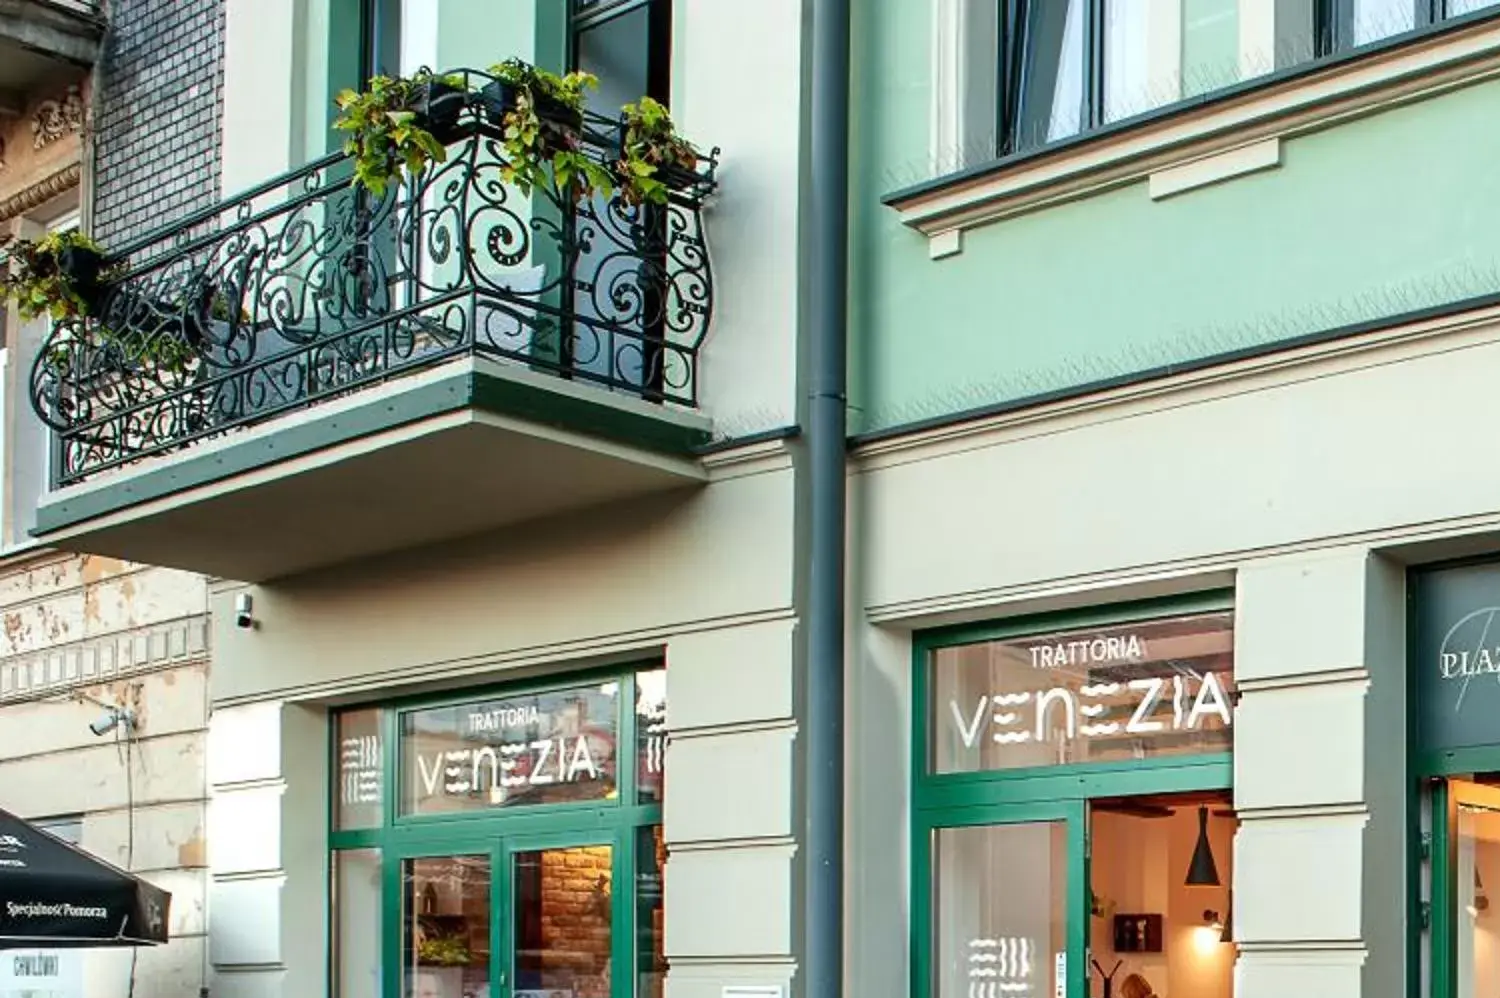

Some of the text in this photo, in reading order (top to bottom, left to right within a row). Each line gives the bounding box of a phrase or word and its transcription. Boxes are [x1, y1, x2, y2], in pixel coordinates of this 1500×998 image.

[1029, 635, 1141, 668] TRATTORIA
[468, 705, 541, 732] TRATTORIA
[950, 670, 1232, 748] VENEZIA
[417, 734, 597, 795] VENEZIA
